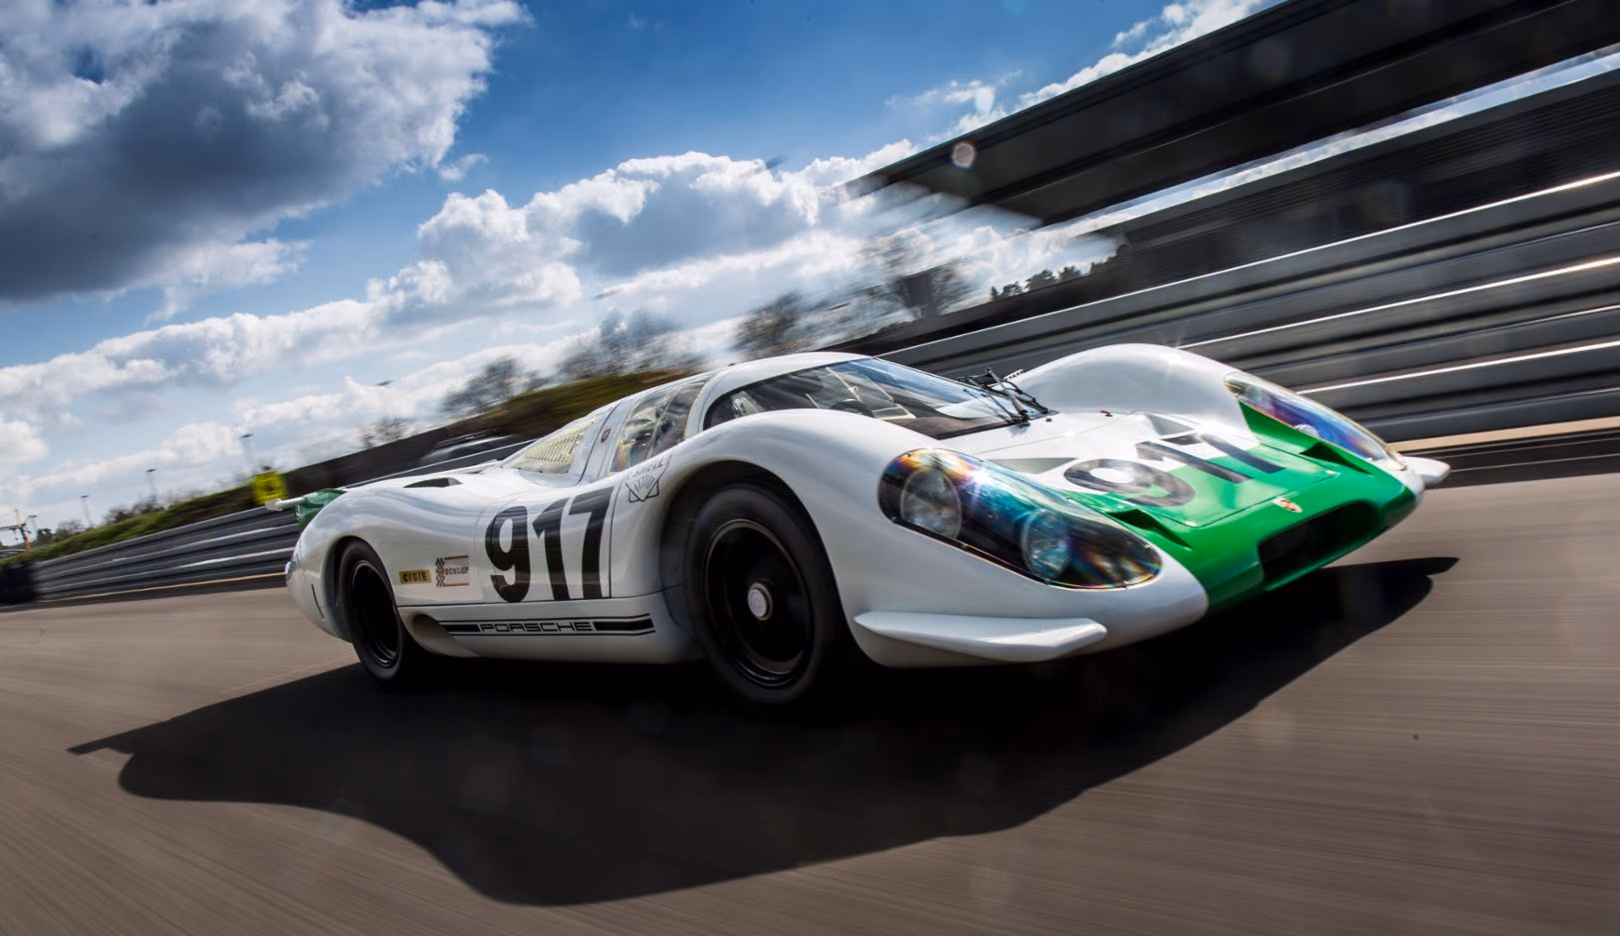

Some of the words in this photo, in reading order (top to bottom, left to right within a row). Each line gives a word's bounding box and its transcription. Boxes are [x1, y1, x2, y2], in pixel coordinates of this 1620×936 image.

[1063, 434, 1286, 507] 917
[485, 486, 616, 603] 917
[445, 566, 469, 576] DUNLOP
[479, 621, 593, 632] PORSCHE
